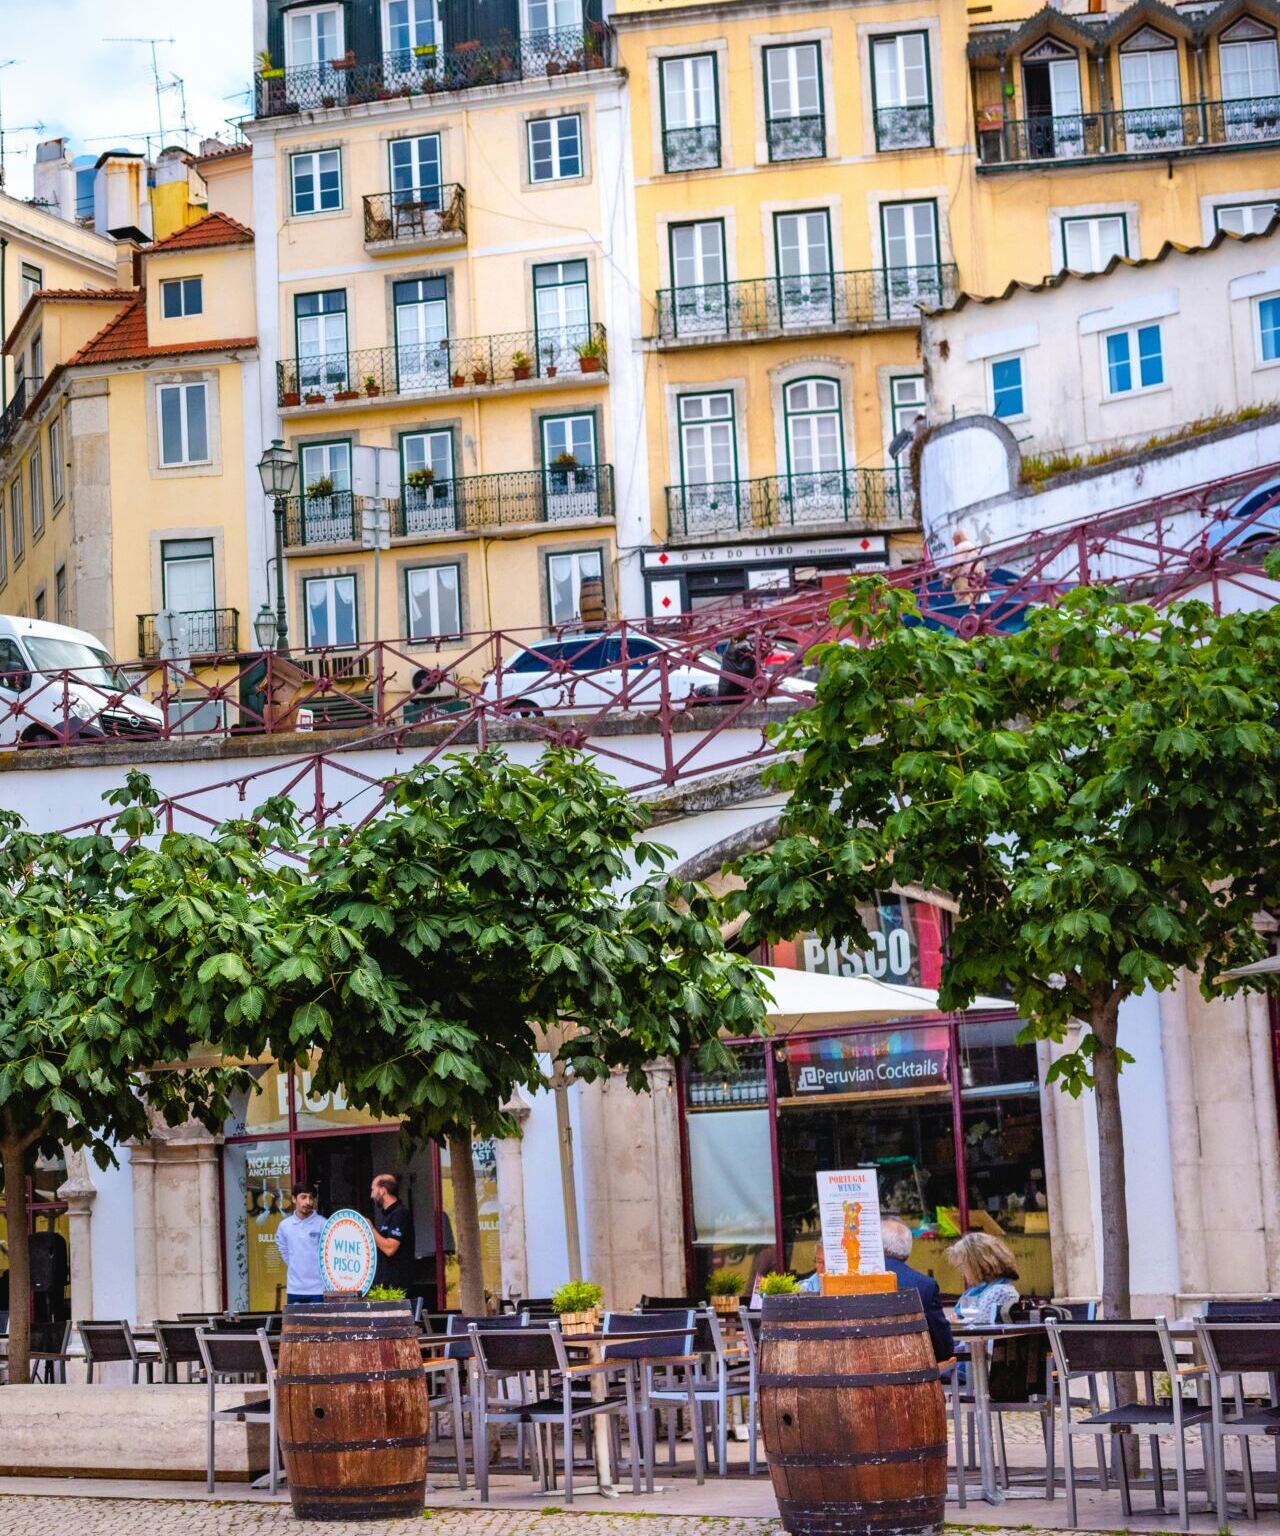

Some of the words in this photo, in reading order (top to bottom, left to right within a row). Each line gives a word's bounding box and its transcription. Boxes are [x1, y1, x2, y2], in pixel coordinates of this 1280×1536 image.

[728, 549, 742, 558] DO
[755, 545, 793, 557] LIVRO
[804, 929, 911, 978] PISCO
[816, 1066, 874, 1085] Peruvian
[876, 1058, 938, 1080] Cocktails
[471, 1139, 497, 1151] ODKA
[248, 1156, 269, 1169] NOT
[271, 1154, 290, 1168] JUS
[472, 1150, 491, 1161] AST
[248, 1167, 282, 1177] ANOTHER
[828, 1174, 866, 1185] PORTUGAL
[837, 1183, 862, 1193] WINES
[334, 1238, 362, 1256] WINE
[333, 1256, 361, 1274] PISCO
